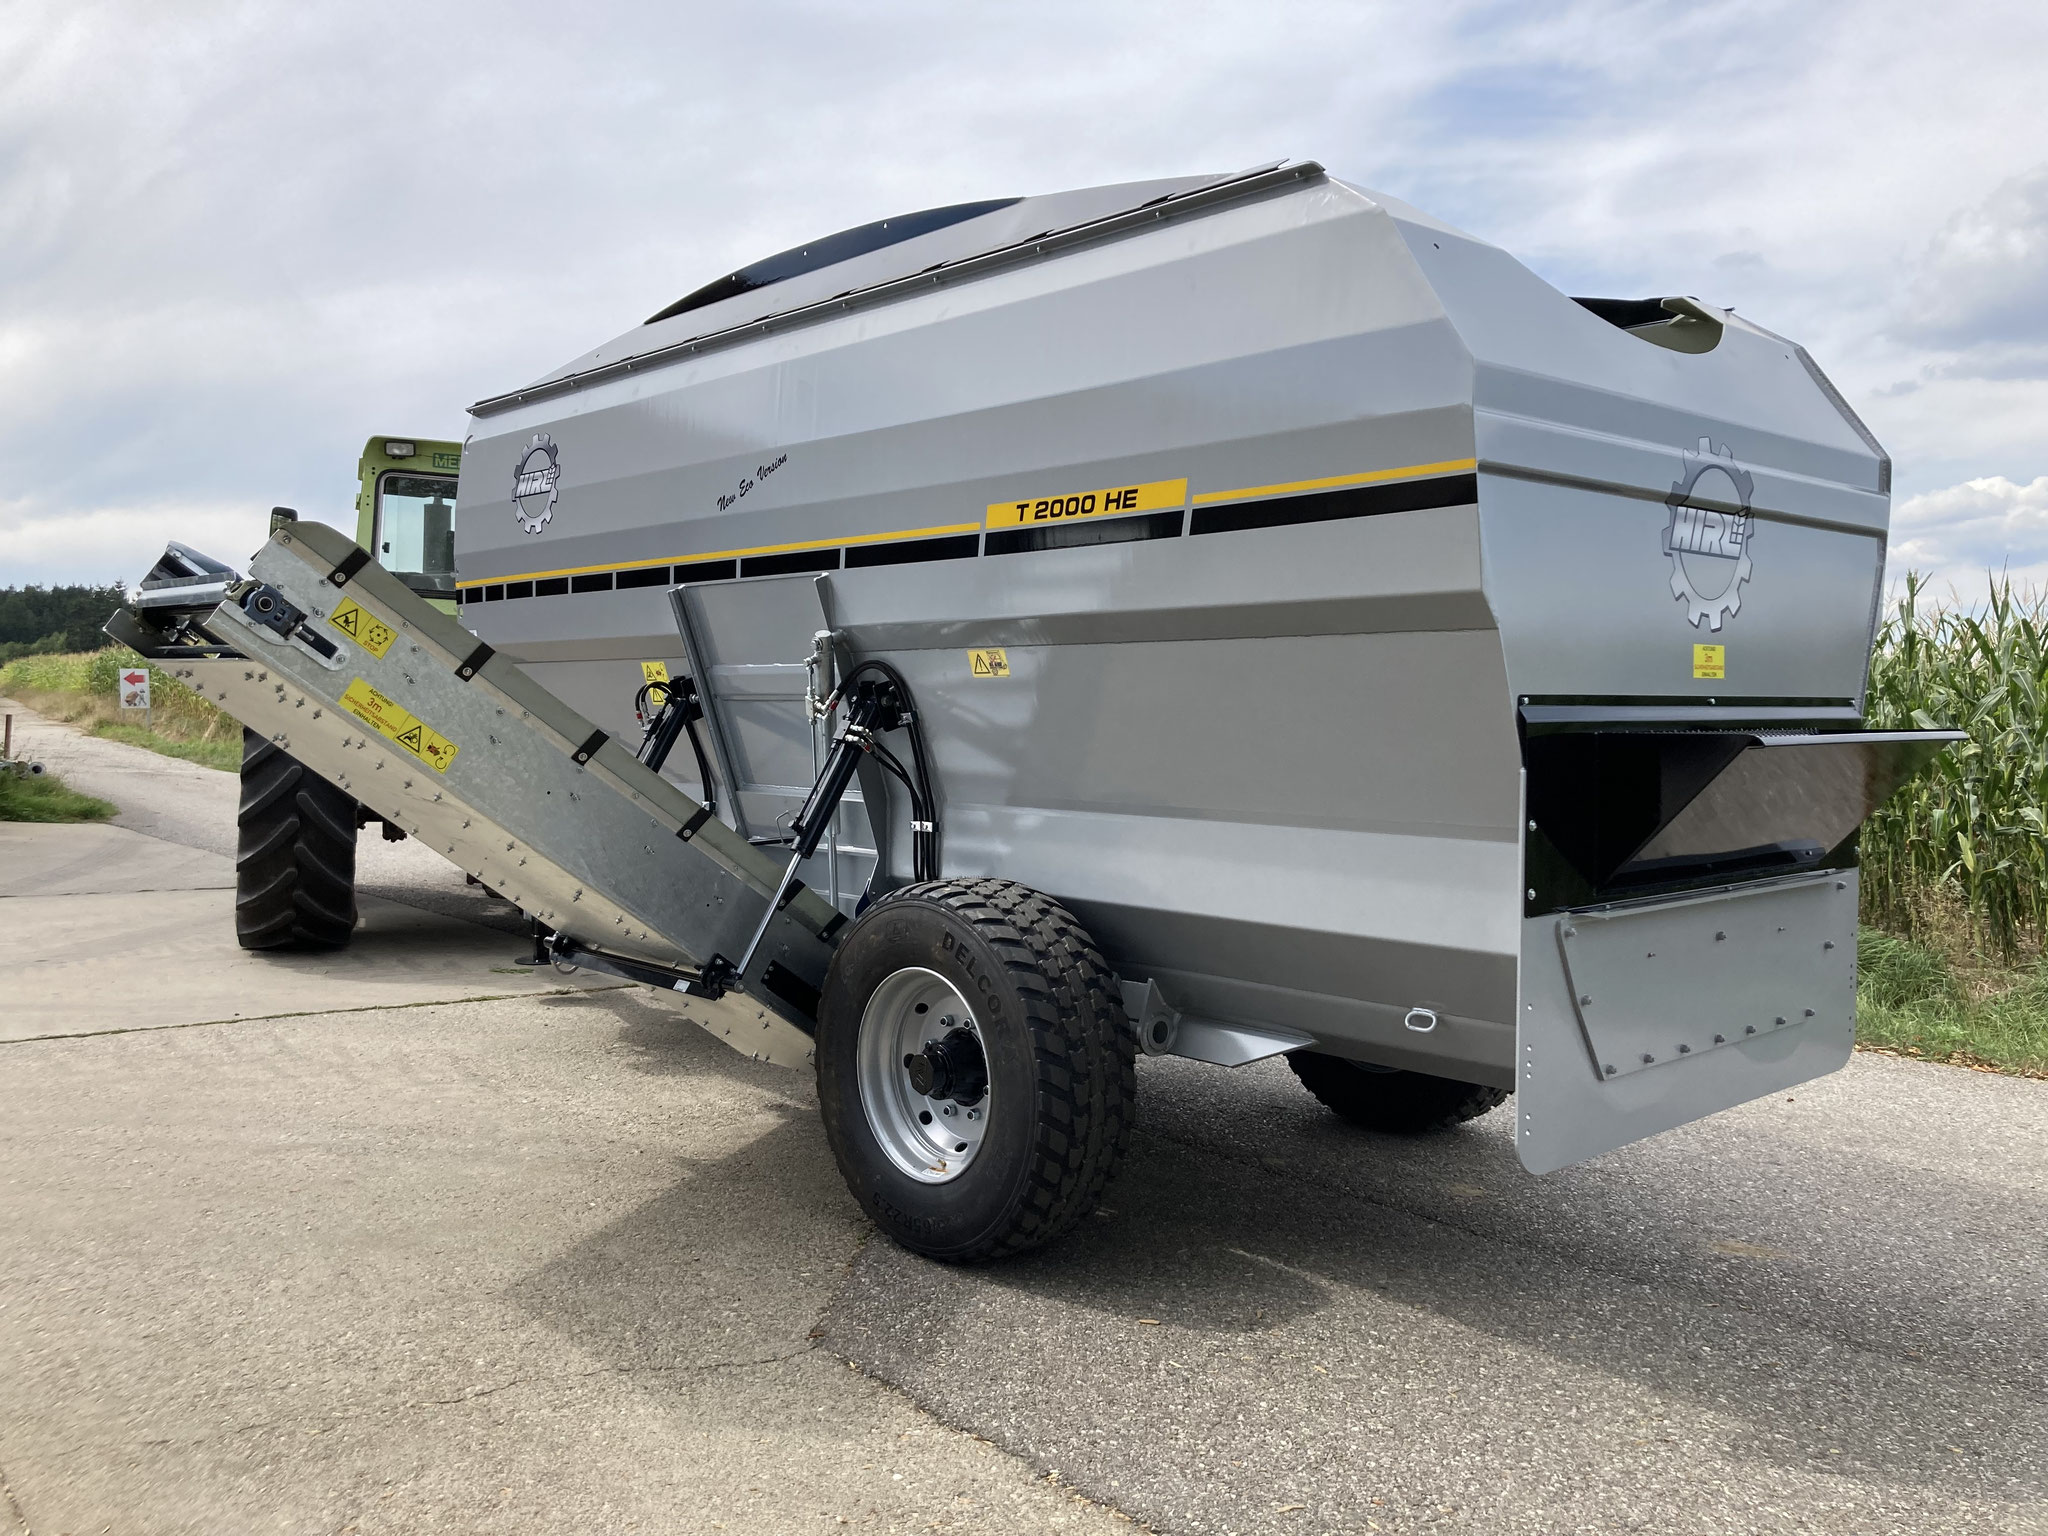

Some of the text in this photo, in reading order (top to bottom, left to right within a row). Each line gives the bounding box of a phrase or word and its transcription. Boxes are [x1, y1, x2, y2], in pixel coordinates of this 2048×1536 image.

[717, 453, 787, 512] New Eco Version
[1016, 488, 1138, 522] T 2000 HE
[363, 640, 379, 652] STOP
[367, 697, 383, 713] 3m
[353, 708, 381, 730] EINHALTEN
